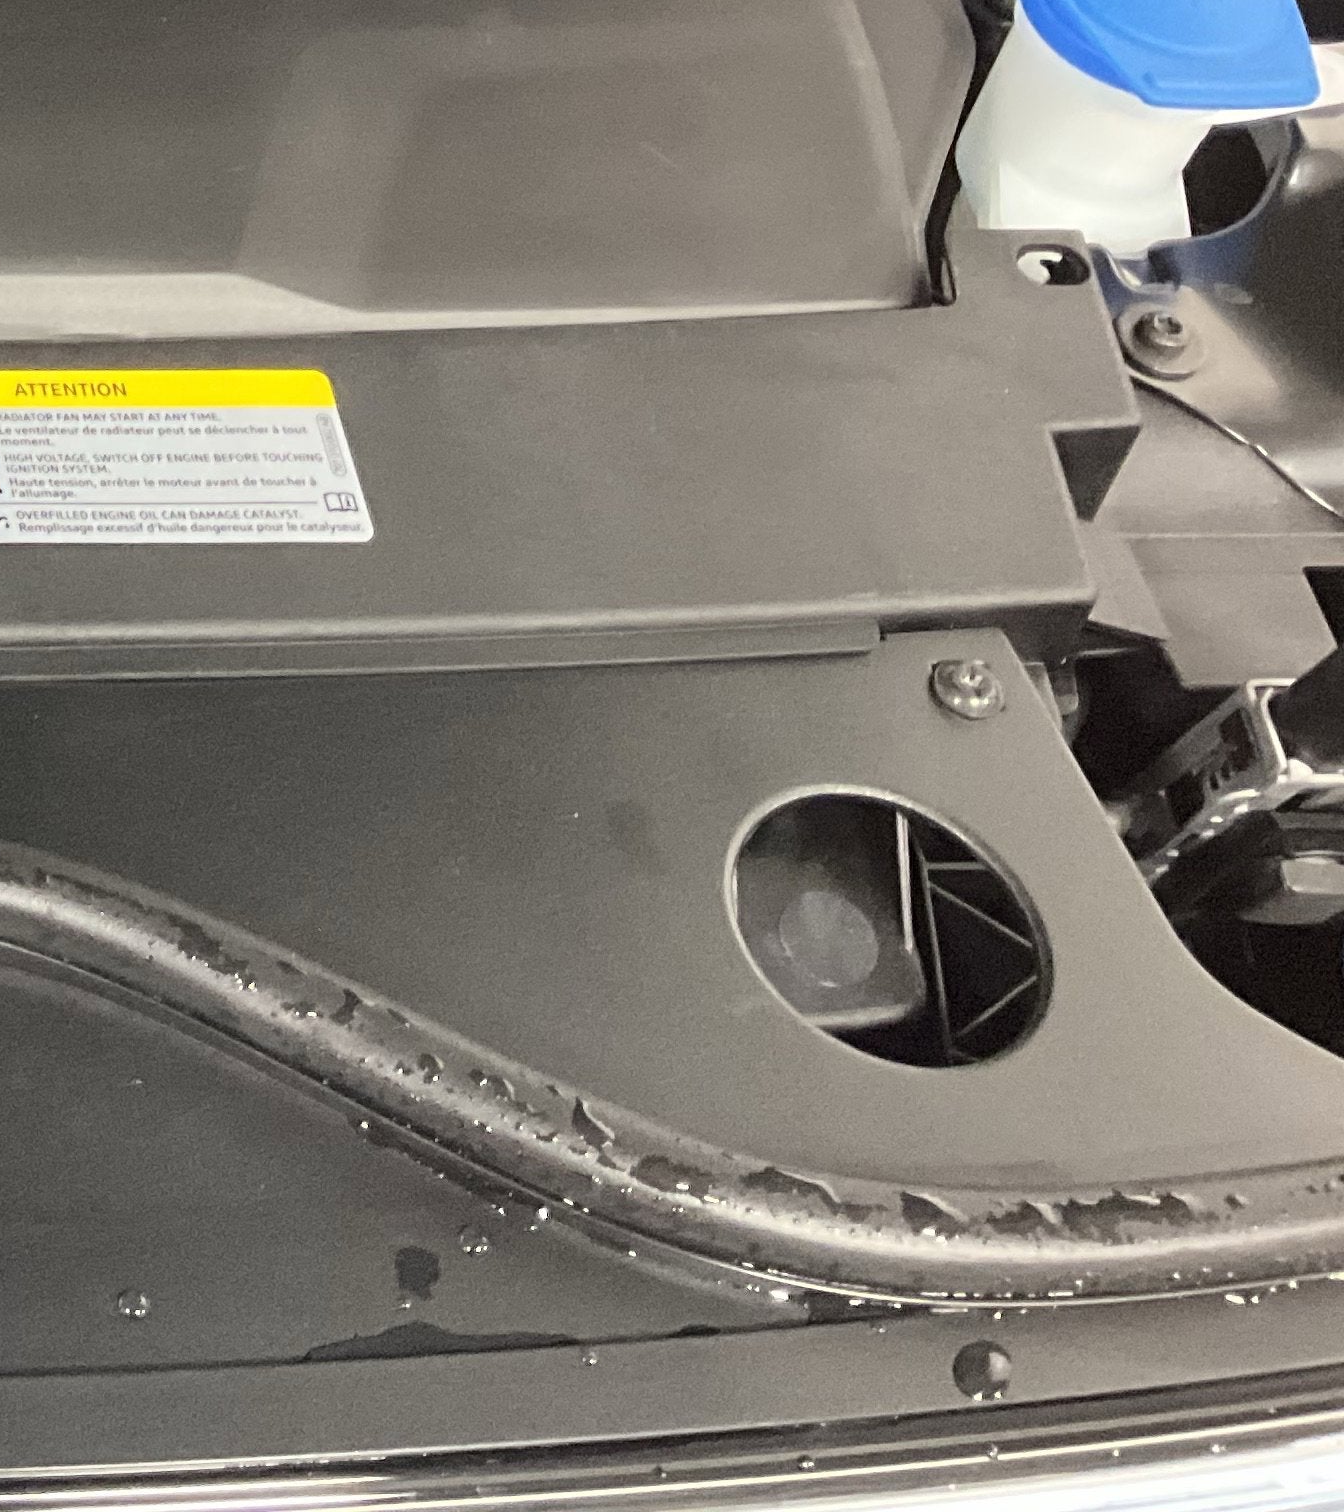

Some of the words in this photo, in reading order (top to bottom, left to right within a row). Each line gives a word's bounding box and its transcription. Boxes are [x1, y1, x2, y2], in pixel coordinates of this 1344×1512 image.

[14, 382, 128, 397] ATTENTION
[56, 412, 79, 422] FAN
[82, 412, 107, 422] MAY
[109, 412, 144, 422] START
[148, 412, 161, 421] AT
[164, 412, 187, 421] ANY
[14, 425, 78, 435] ventilateur
[82, 425, 97, 435] de
[100, 425, 154, 435] radiateur
[157, 426, 185, 436] peut
[188, 426, 201, 434] se
[282, 425, 307, 434] tout
[4, 454, 33, 462] HIGH
[92, 454, 138, 463] SWITCH
[141, 454, 163, 462] OFF
[166, 453, 210, 463] ENGINE
[214, 453, 259, 463] BEFORE
[263, 453, 323, 463] TOUCHING
[6, 464, 59, 474] IGNITION
[16, 510, 88, 520] OVERFILLED
[91, 510, 136, 520] ENGINE
[139, 510, 158, 520] OIL
[162, 510, 187, 520] CAN
[189, 510, 240, 519] DAMAGE
[19, 522, 94, 535] Remplissage
[97, 522, 144, 533] excessif
[190, 523, 253, 534] dangereux
[256, 523, 284, 534] pour
[286, 522, 298, 532] le
